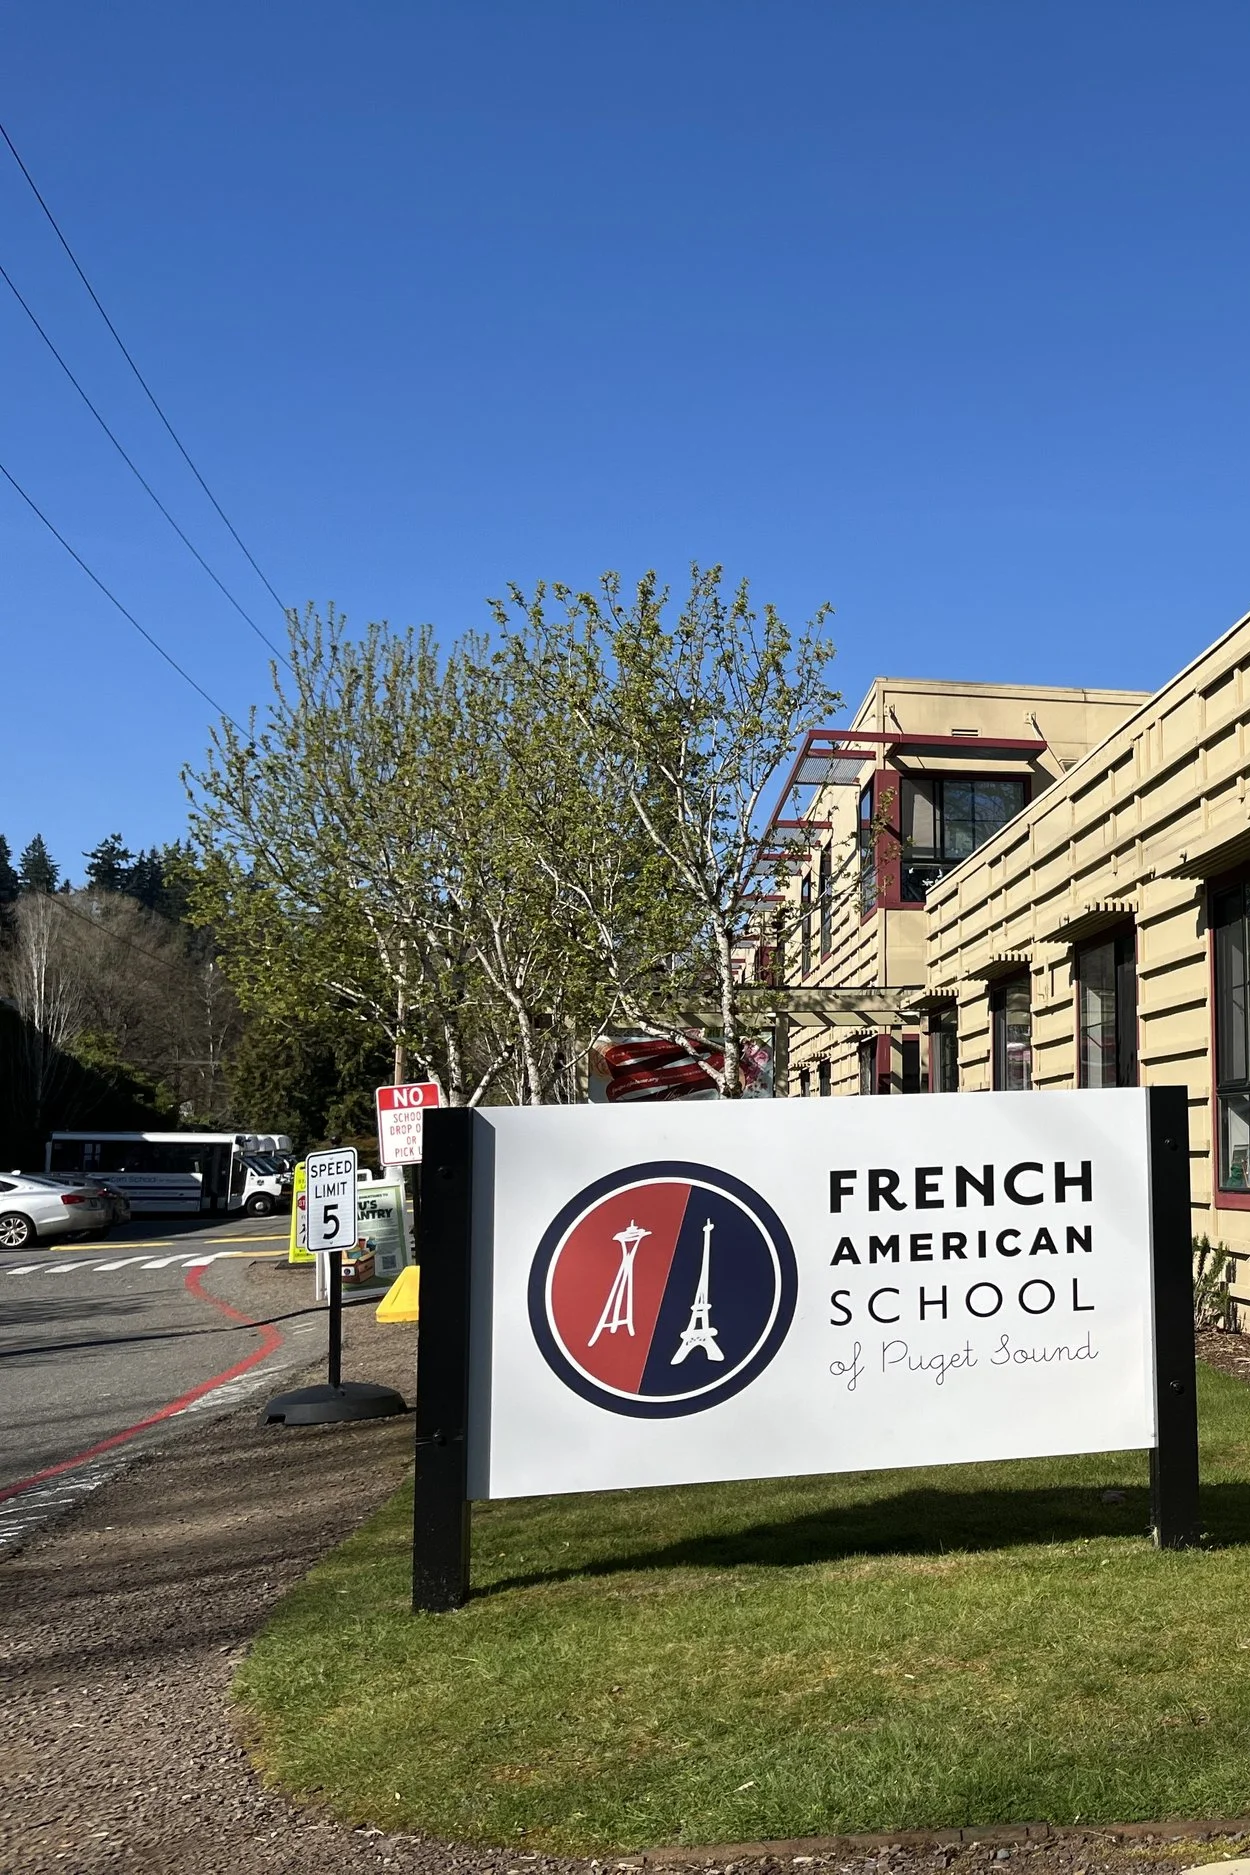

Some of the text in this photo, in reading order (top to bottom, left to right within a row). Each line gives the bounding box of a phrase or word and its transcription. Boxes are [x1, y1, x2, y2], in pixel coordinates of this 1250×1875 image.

[393, 1087, 424, 1108] NO
[393, 1111, 422, 1124] SCHOO
[390, 1124, 412, 1136] DROP
[406, 1135, 417, 1145] OR
[395, 1147, 415, 1158] PICK
[310, 1160, 352, 1178] SPEED
[315, 1181, 347, 1199] LIMIT
[829, 1160, 1093, 1214] FRENCH
[322, 1203, 340, 1240] 5
[829, 1224, 1093, 1267] AMERICAN
[829, 1277, 1096, 1327] SCHOOL
[829, 1331, 1099, 1392] of Puget Sound
